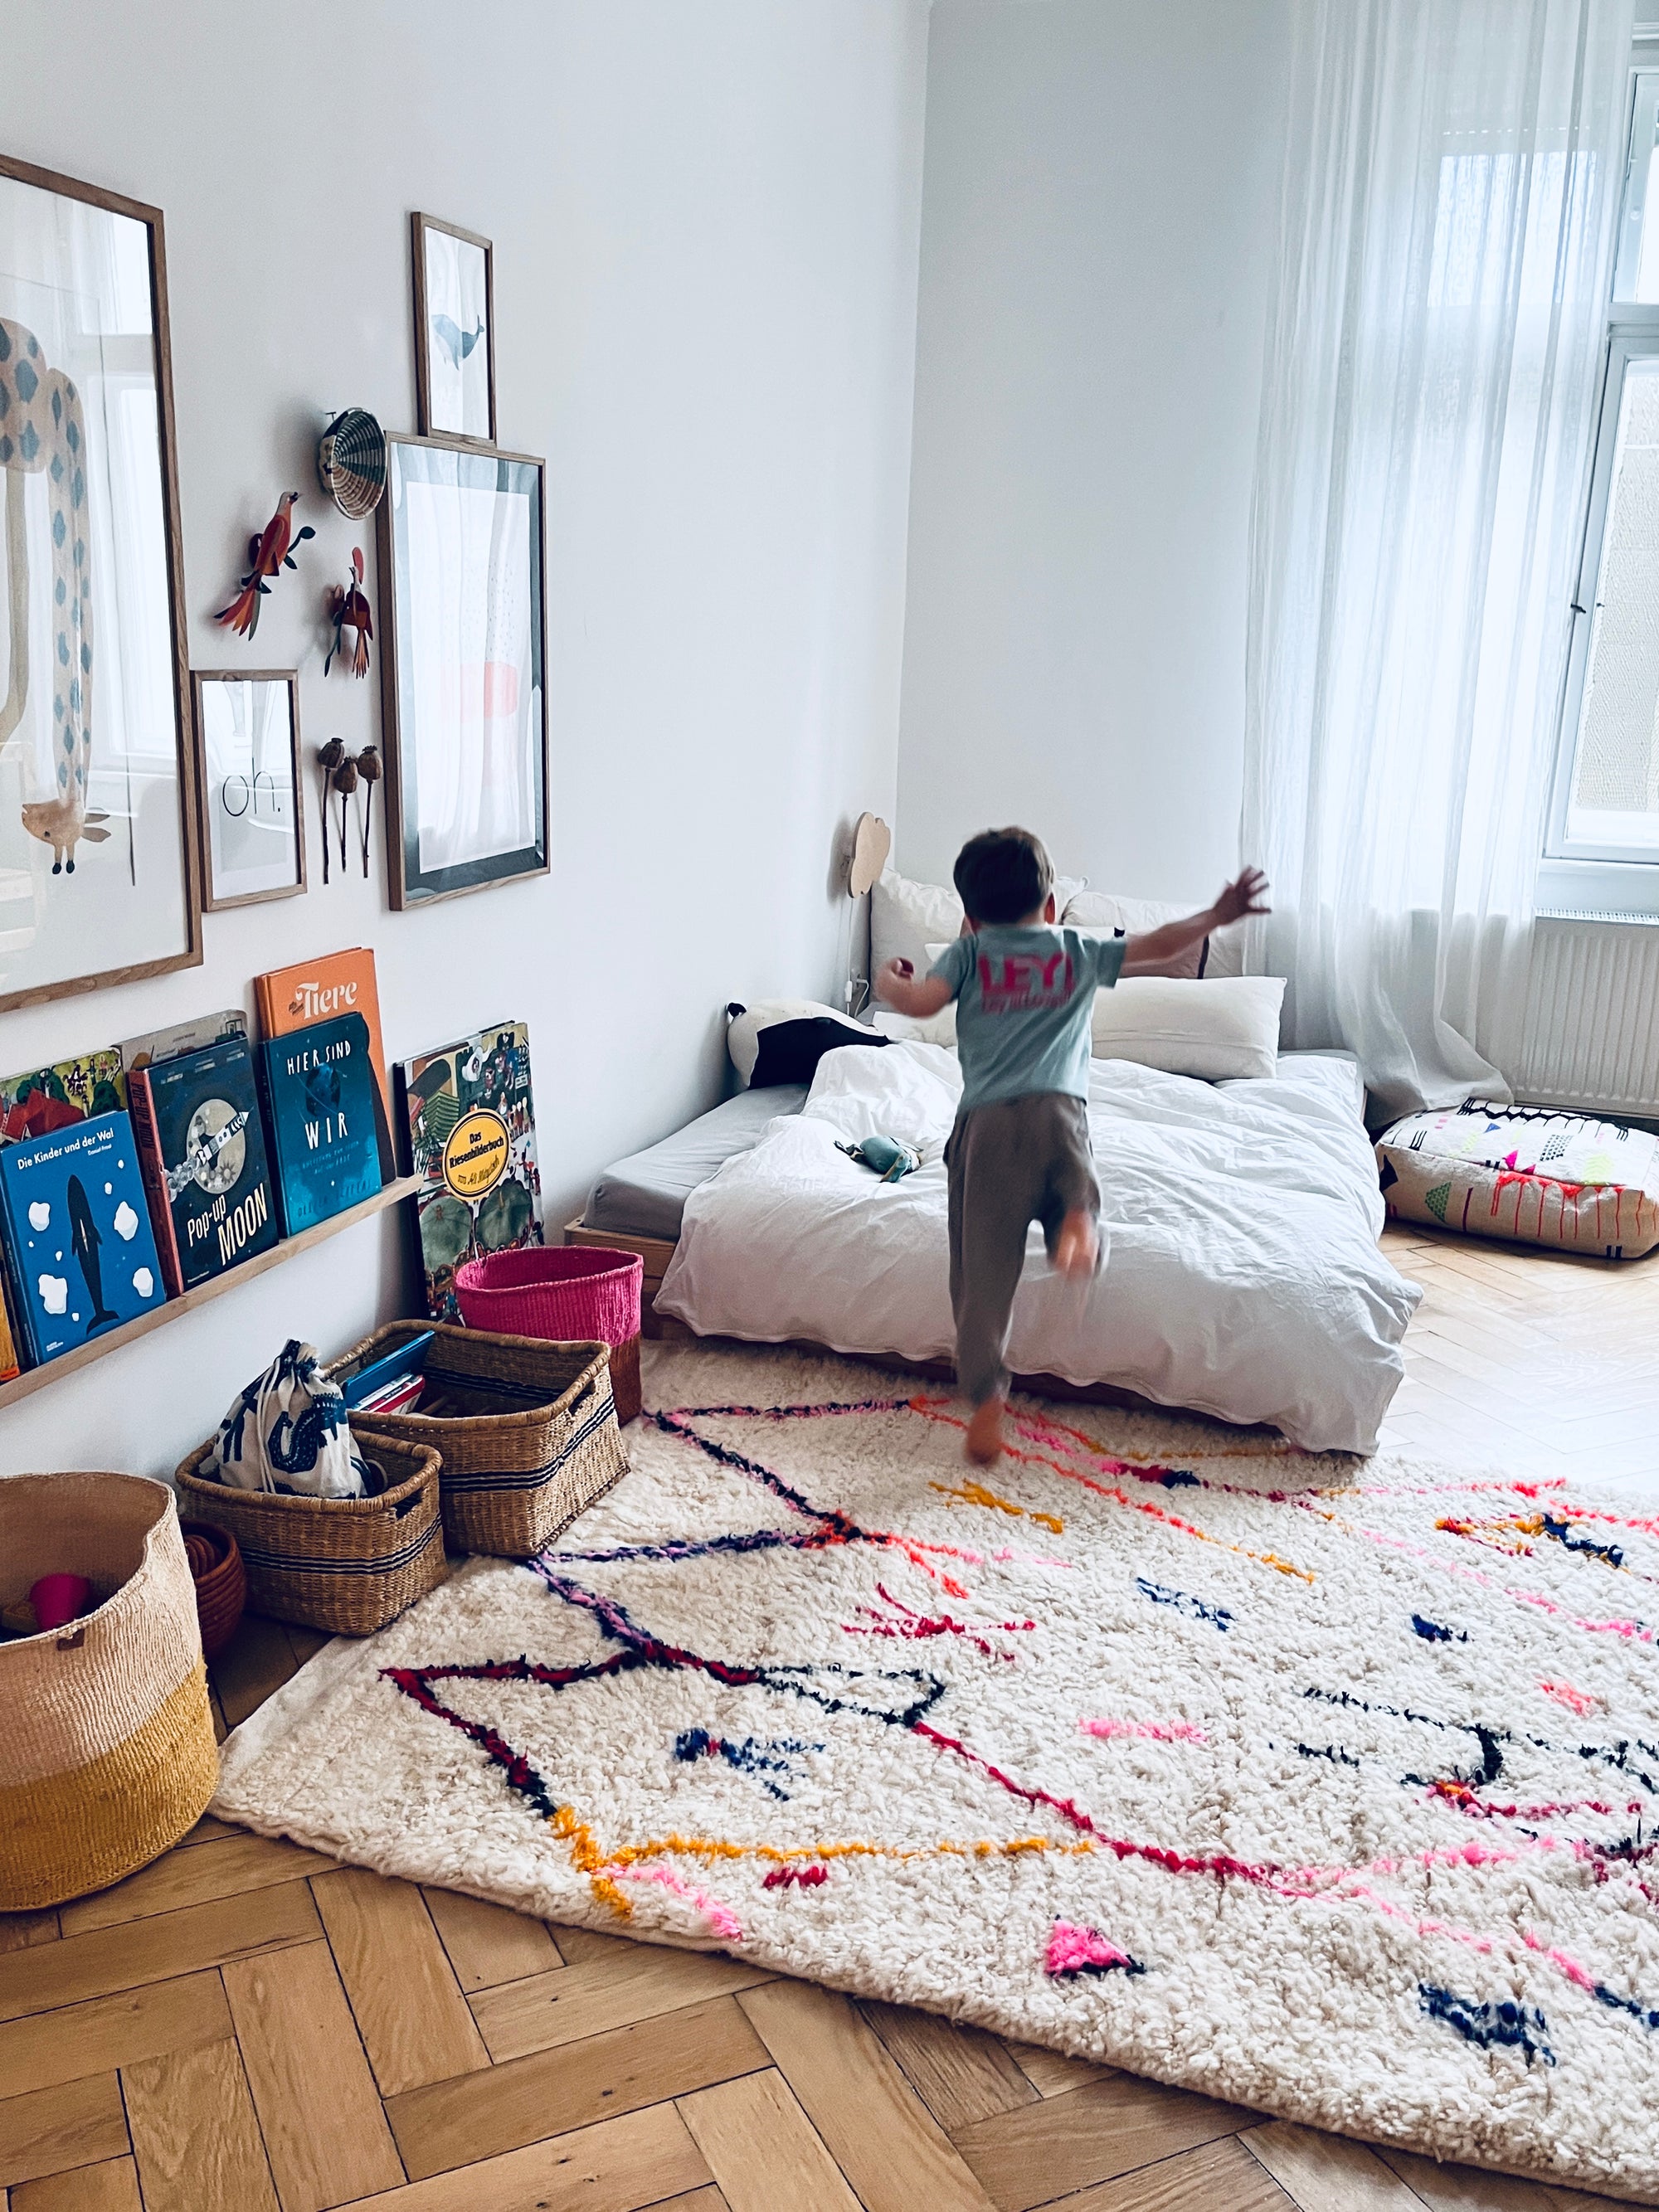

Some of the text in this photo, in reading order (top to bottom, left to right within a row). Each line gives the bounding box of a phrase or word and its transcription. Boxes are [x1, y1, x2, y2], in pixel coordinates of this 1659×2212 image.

[221, 757, 280, 816] oh.
[295, 982, 358, 1019] Tiere
[287, 1040, 351, 1075] HIER SIND
[17, 1158, 32, 1170] Die
[34, 1147, 63, 1164] Kinder
[65, 1139, 80, 1154] und
[81, 1135, 95, 1148] der
[96, 1127, 114, 1142] Wal
[304, 1112, 348, 1150] WIR
[469, 1132, 482, 1145] Das
[449, 1136, 504, 1169] Riesenbilderbuch
[187, 1194, 226, 1247] Pop-up
[217, 1182, 267, 1266] MOON
